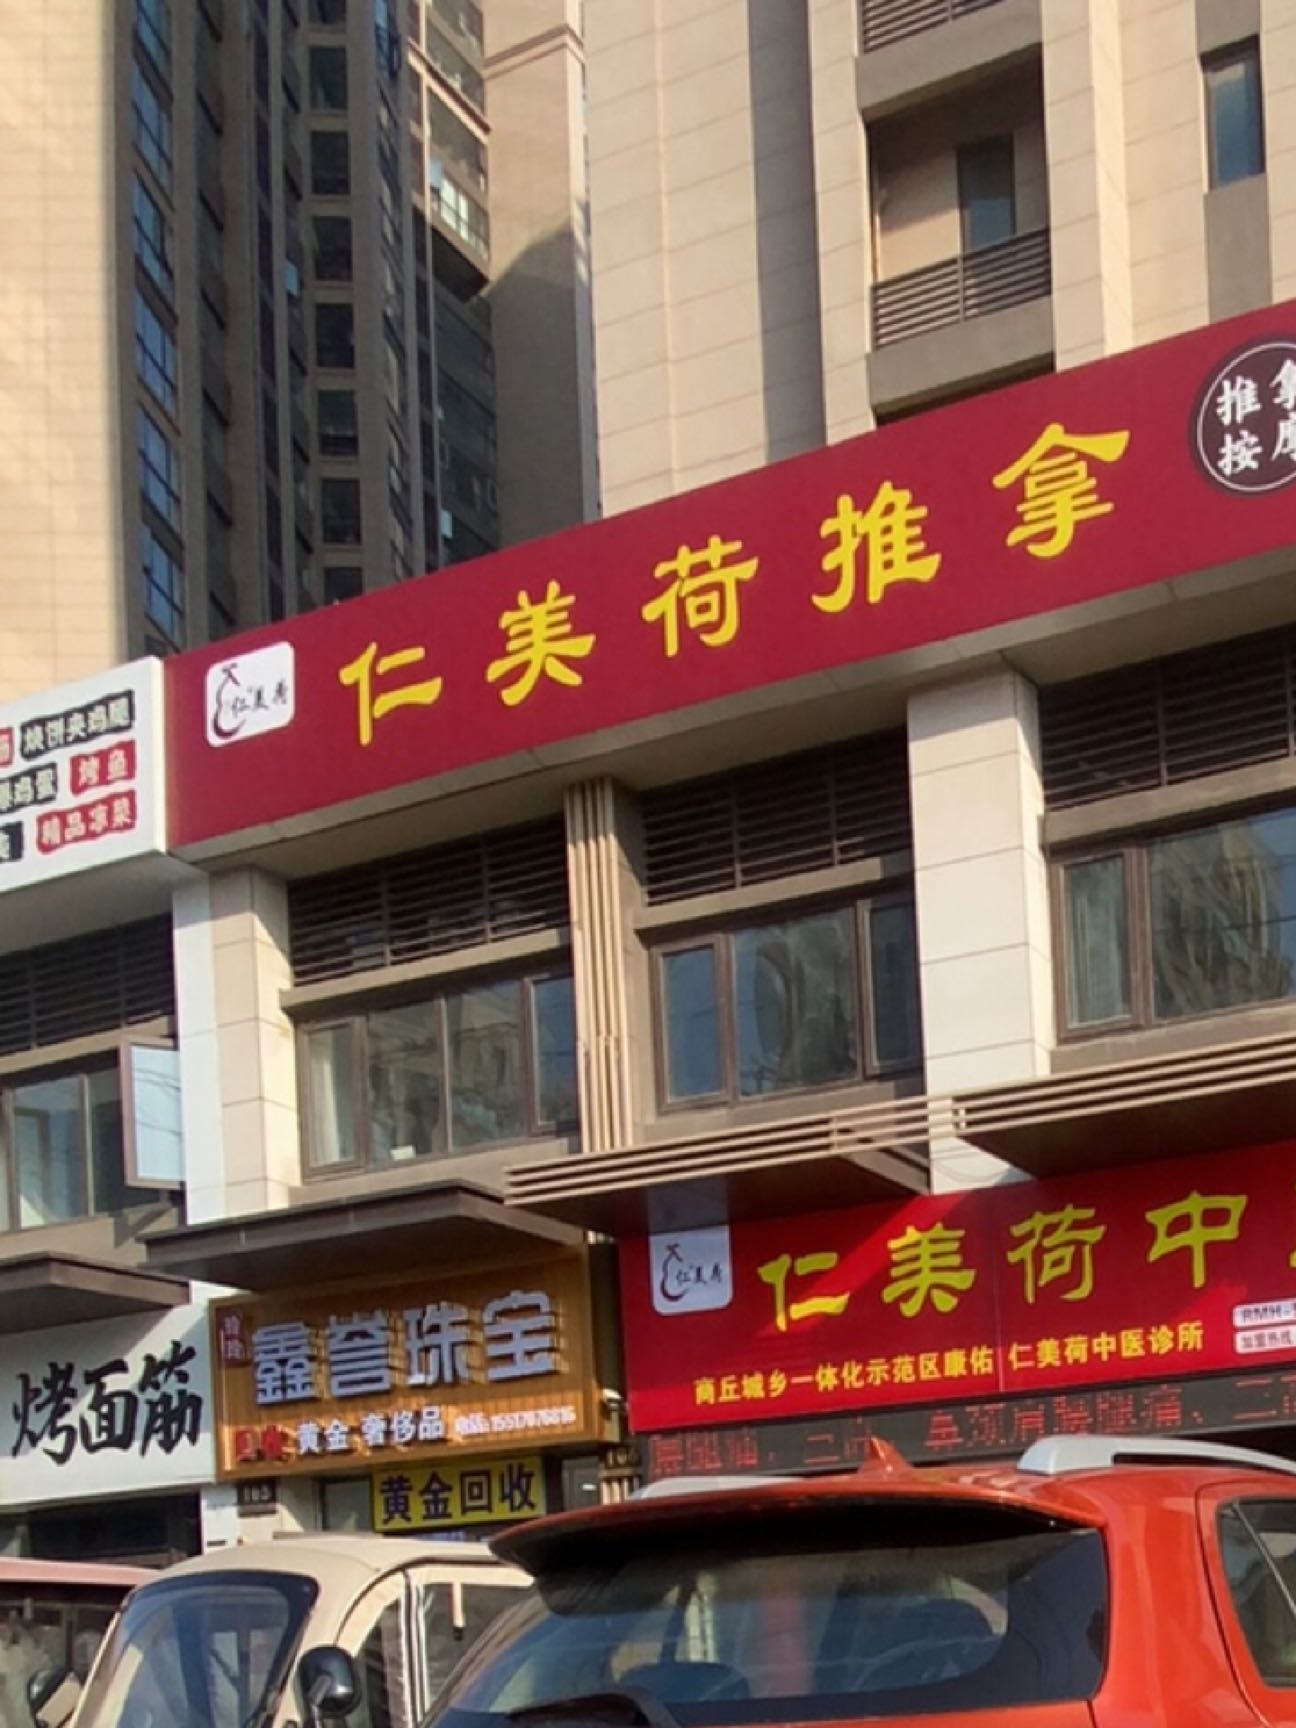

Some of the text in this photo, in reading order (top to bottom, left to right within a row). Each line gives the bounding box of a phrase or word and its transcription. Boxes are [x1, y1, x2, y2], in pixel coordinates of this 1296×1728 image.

[338, 422, 1130, 746] 仁美荷推拿
[251, 1290, 560, 1405] 鑫誉珠宝
[1009, 1320, 1206, 1372] 仁美荷中医诊所
[11, 1341, 204, 1466] 烤面筋
[297, 1418, 350, 1456] 黄金
[362, 1405, 445, 1447] 奢侈品
[380, 1462, 536, 1525] 黄金回收
